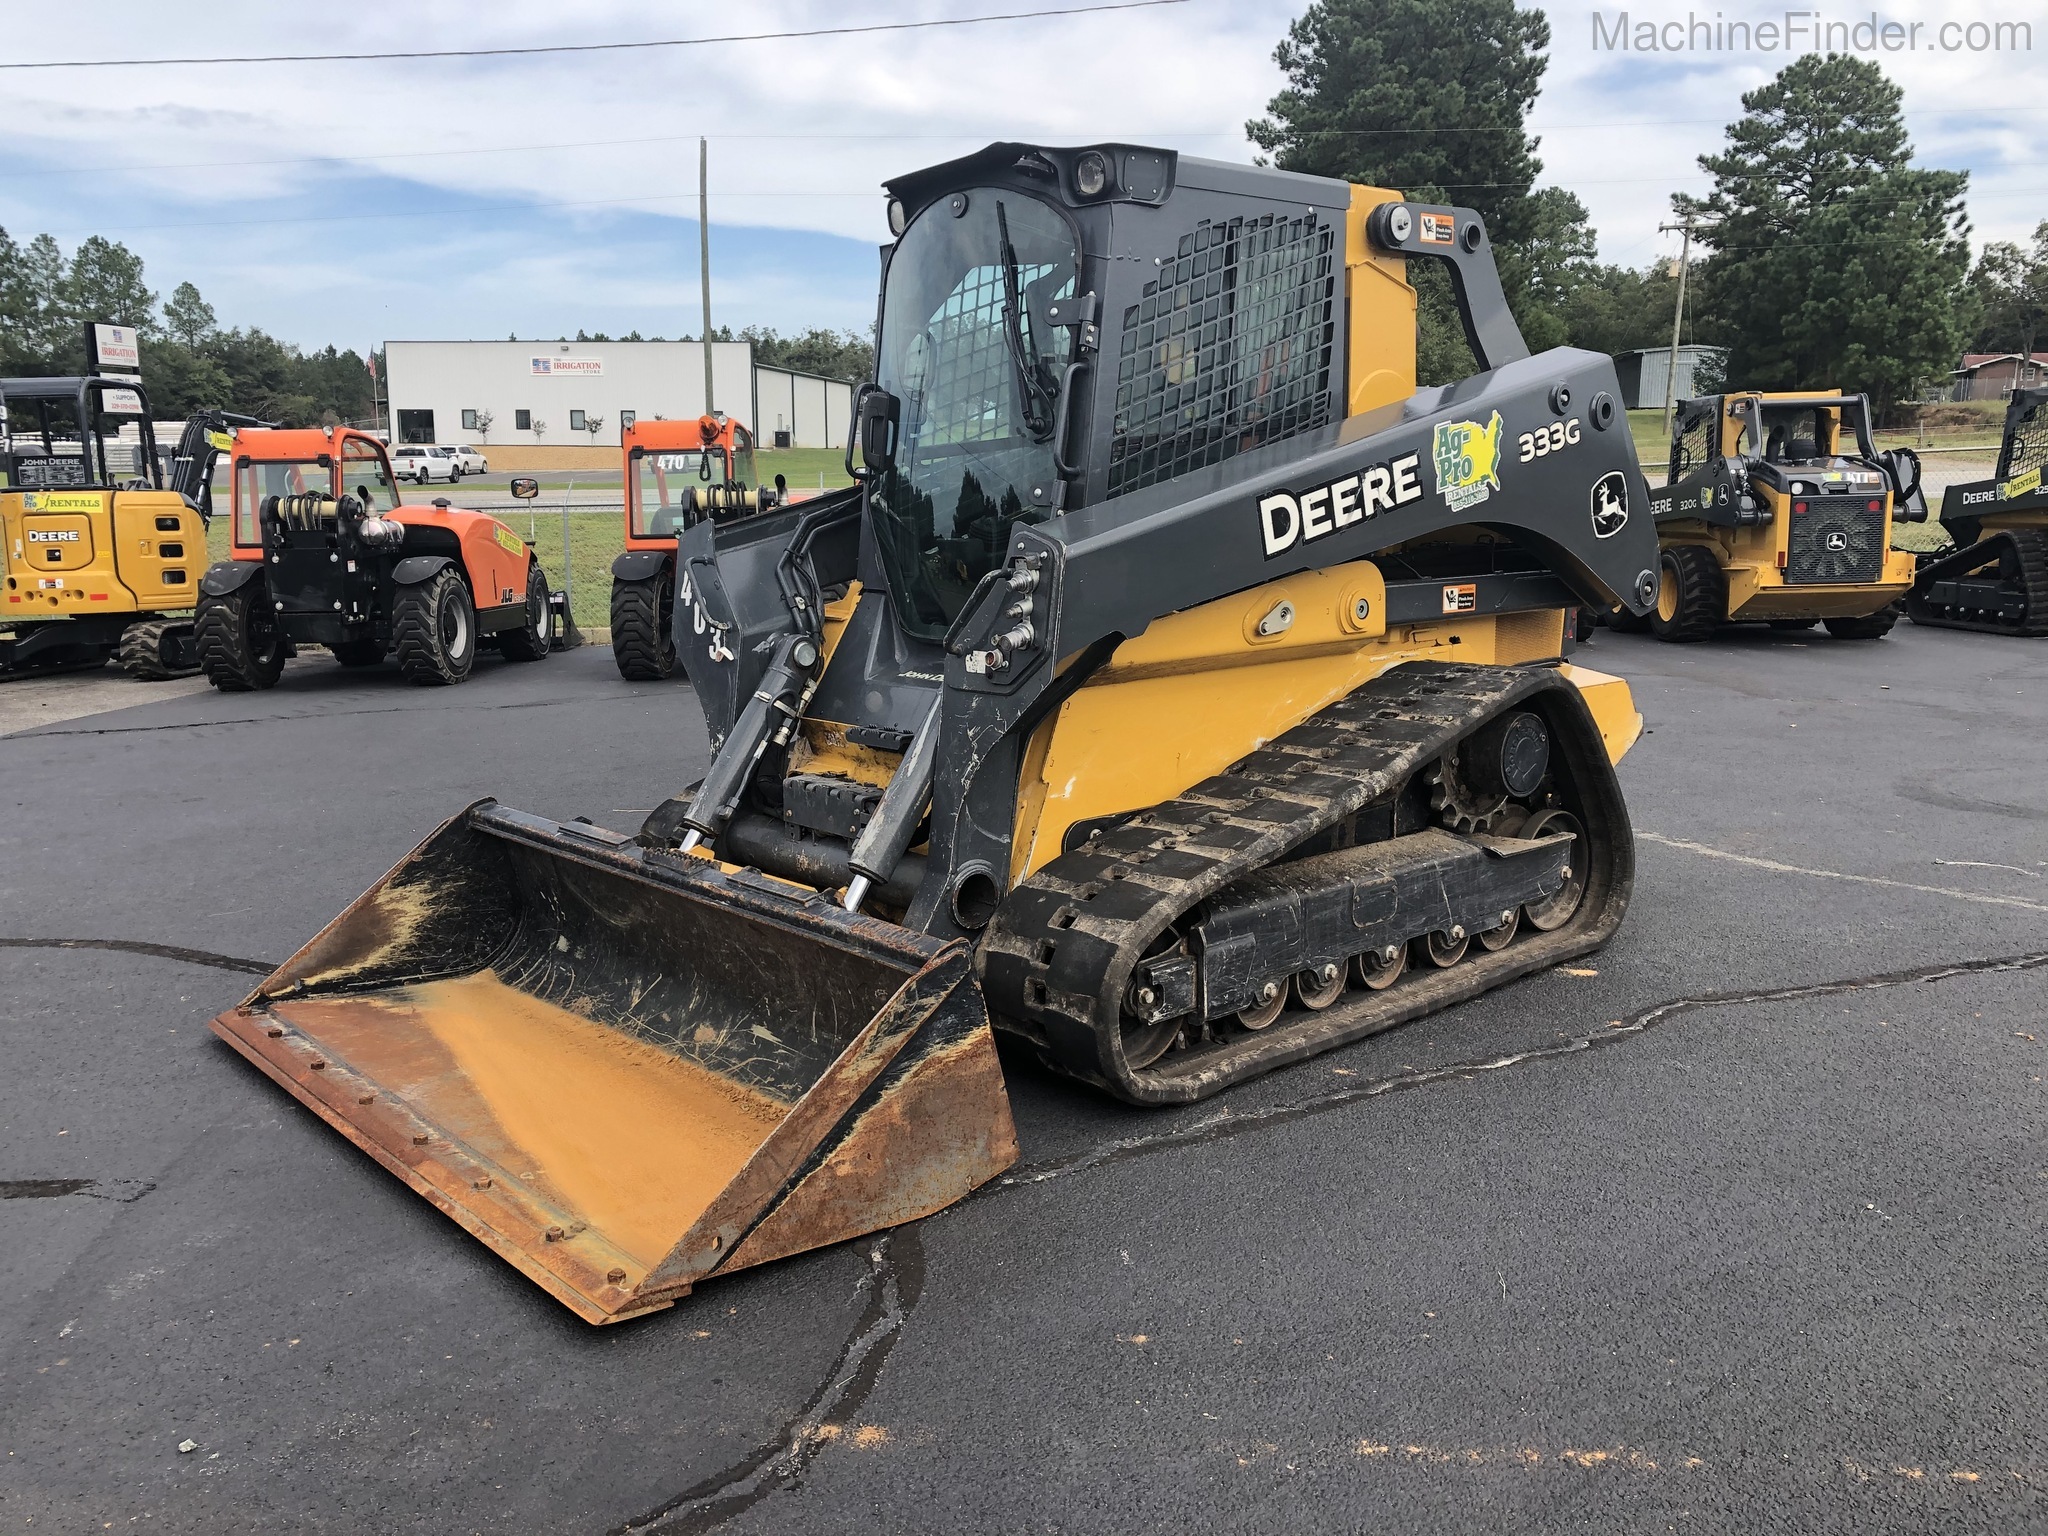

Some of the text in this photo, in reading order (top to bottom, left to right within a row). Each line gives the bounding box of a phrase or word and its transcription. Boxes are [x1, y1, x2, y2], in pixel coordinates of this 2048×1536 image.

[101, 346, 136, 358] IRRIGATION
[553, 362, 601, 370] IRRIGATION
[1437, 425, 1470, 459] Ag-
[1518, 418, 1581, 463] 333G
[22, 457, 80, 466] JOHN DEERE
[657, 455, 684, 469] 470
[1439, 456, 1473, 488] Pro
[2013, 473, 2040, 491] RENTALS
[1260, 454, 1422, 556] DEERE
[1680, 499, 1697, 511] 320G
[1963, 490, 1995, 505] DEERE
[28, 530, 79, 542] DEERE
[501, 588, 513, 603] JLG
